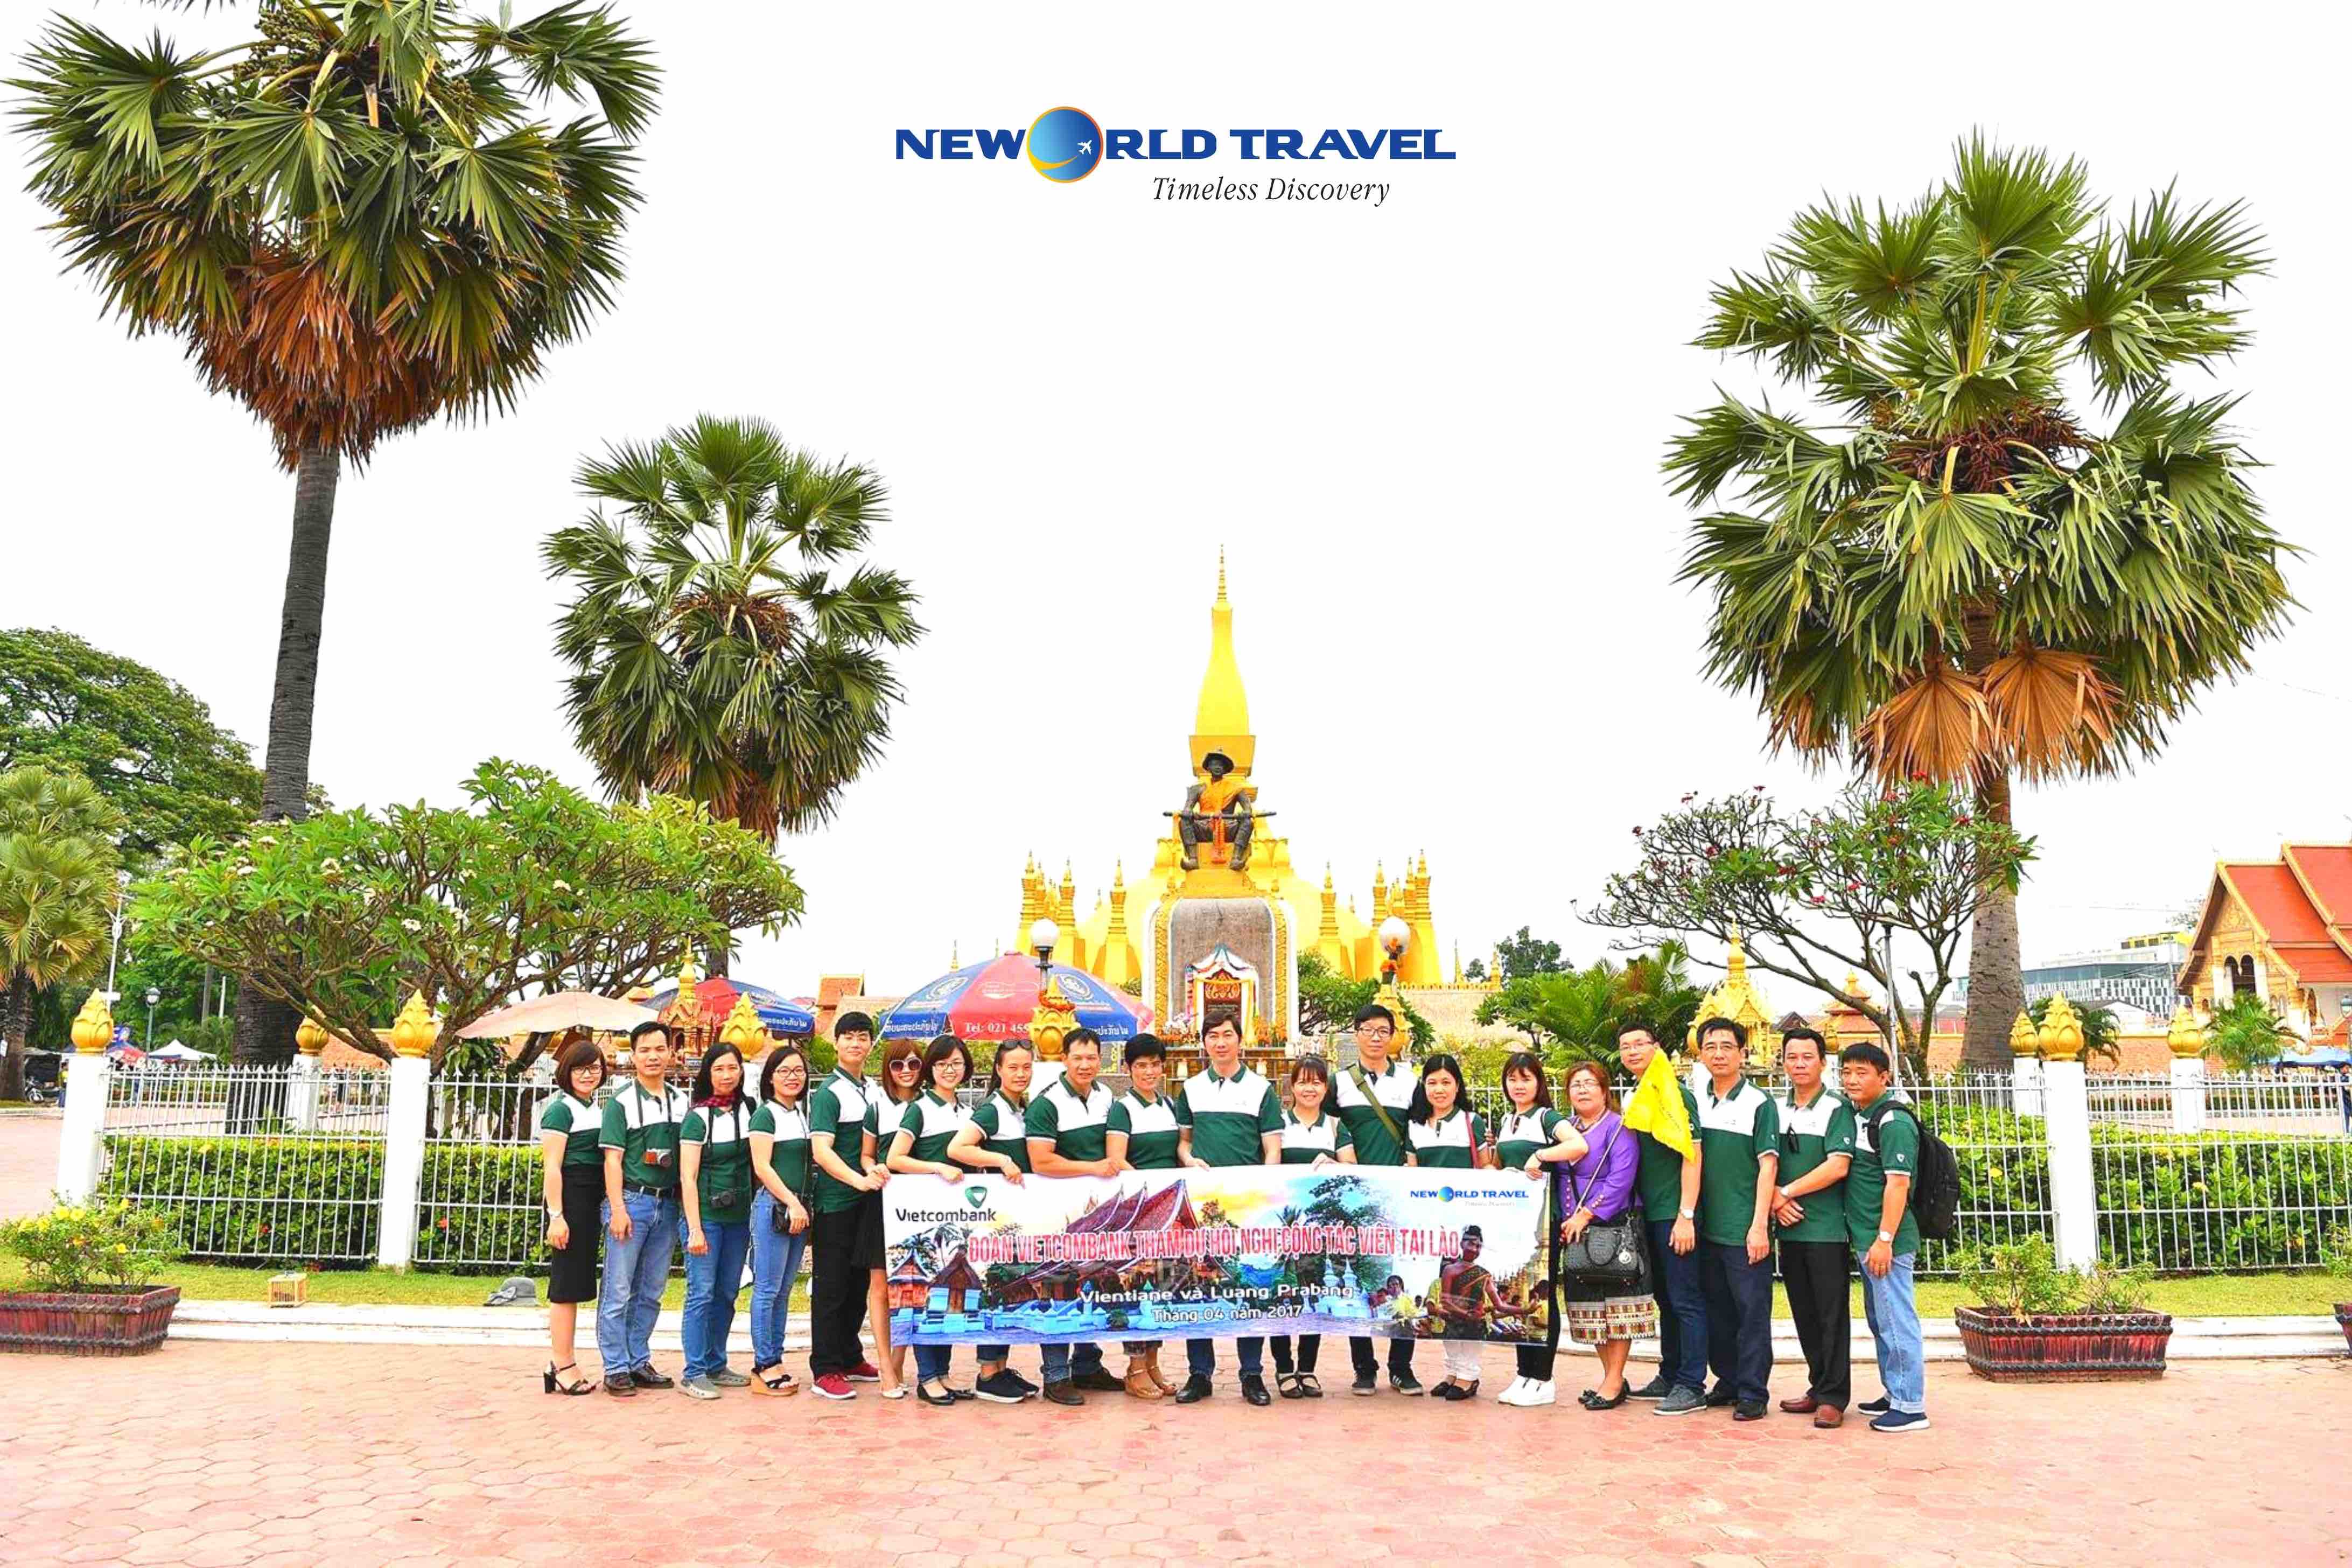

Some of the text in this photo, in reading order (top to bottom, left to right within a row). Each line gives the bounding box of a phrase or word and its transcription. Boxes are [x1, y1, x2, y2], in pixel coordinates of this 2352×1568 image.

[988, 1022, 1006, 1033] 021
[1481, 1190, 1529, 1198] TRAVEL
[895, 1208, 997, 1222] Vietcombank
[968, 1231, 1013, 1263] ĐOÀN
[1017, 1231, 1131, 1263] VIETCOMBANK
[1134, 1230, 1181, 1258] THAM
[1281, 1222, 1322, 1258] CỘNG
[1325, 1221, 1356, 1255] TÁC
[1358, 1223, 1395, 1255] VIÊN
[1399, 1228, 1425, 1261] TẠI
[1429, 1225, 1459, 1257] LÀO
[1080, 1283, 1354, 1303] Vientiane và Luang Prabang
[1152, 1308, 1198, 1323] Tháng
[1203, 1307, 1224, 1320] 04
[1267, 1305, 1304, 1319] 2017
